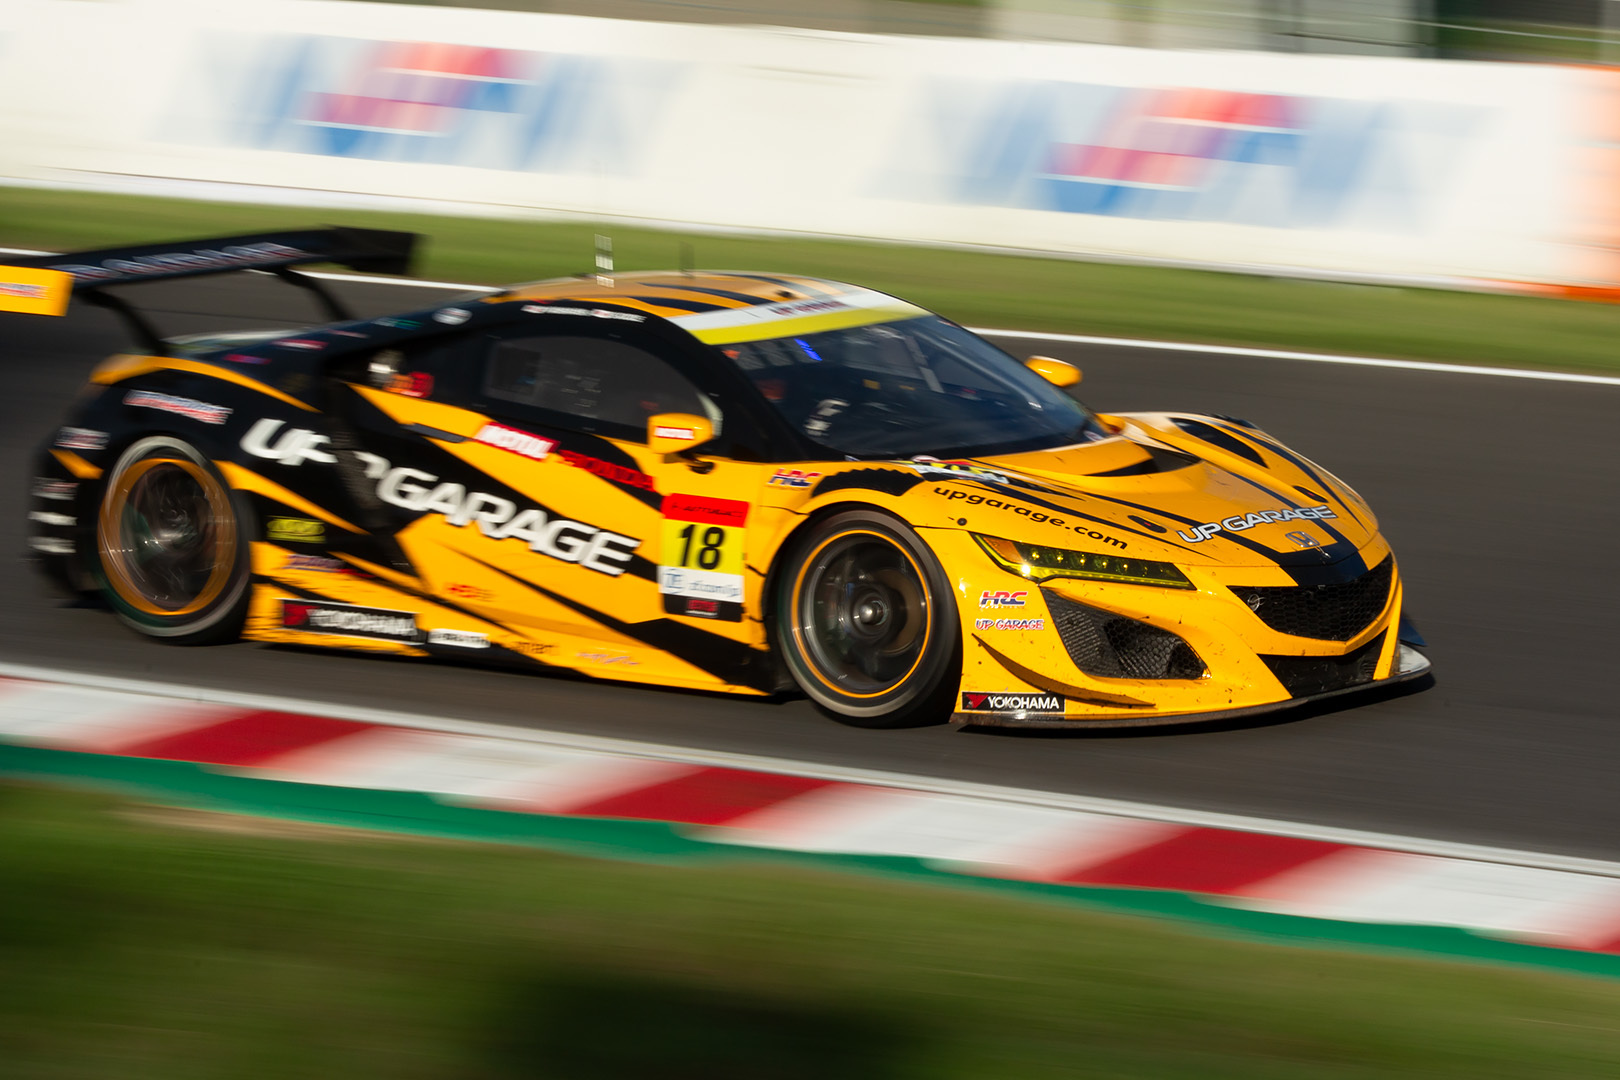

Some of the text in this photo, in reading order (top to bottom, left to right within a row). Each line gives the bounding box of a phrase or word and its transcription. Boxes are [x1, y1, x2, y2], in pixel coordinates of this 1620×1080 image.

[375, 466, 642, 577] GARAGE
[933, 486, 1128, 550] upgarage.com
[1177, 505, 1338, 543] UP GARAGE
[678, 524, 725, 570] 18
[979, 590, 1028, 606] HRC
[975, 618, 1044, 630] UP GARAGE
[988, 695, 1060, 710] YOKOHAMA
